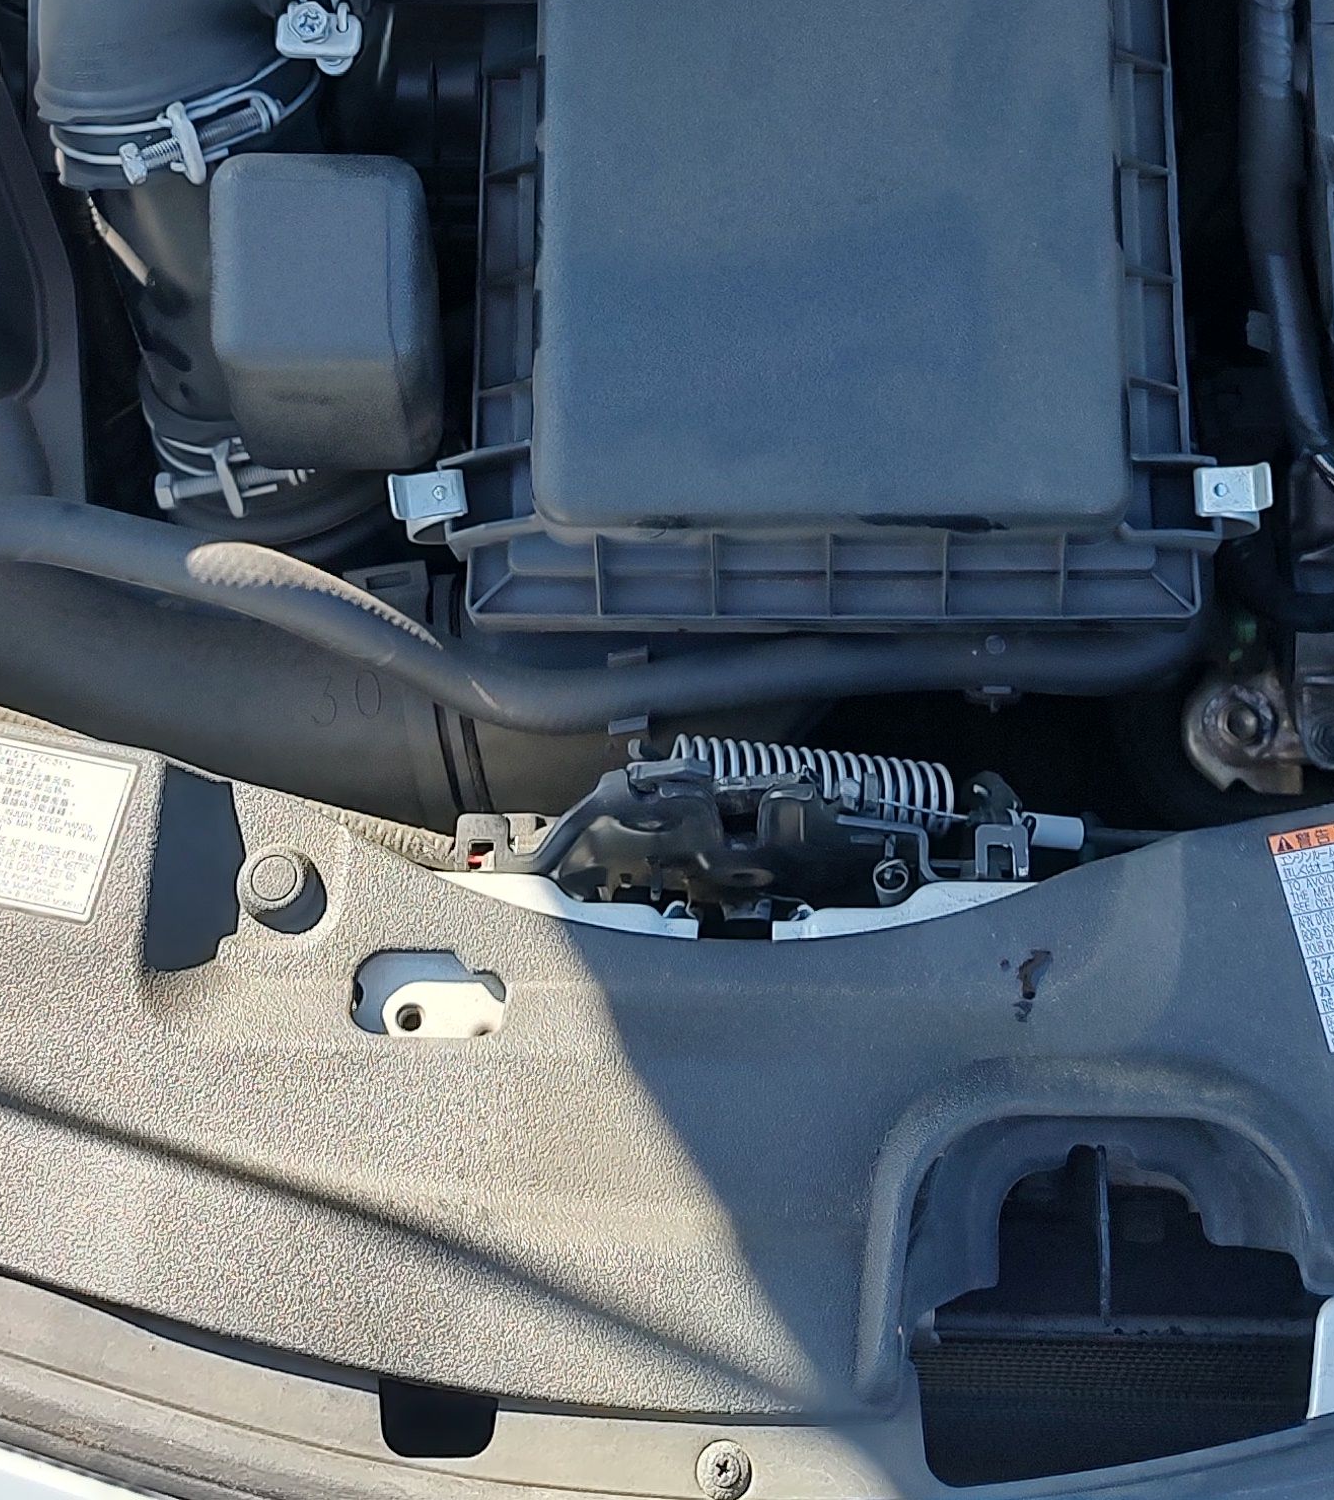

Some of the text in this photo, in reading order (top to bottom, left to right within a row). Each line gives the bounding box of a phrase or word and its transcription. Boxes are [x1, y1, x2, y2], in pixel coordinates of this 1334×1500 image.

[1286, 879, 1301, 891] TO
[1305, 872, 1334, 888] AVOID
[1292, 900, 1311, 913] SEE
